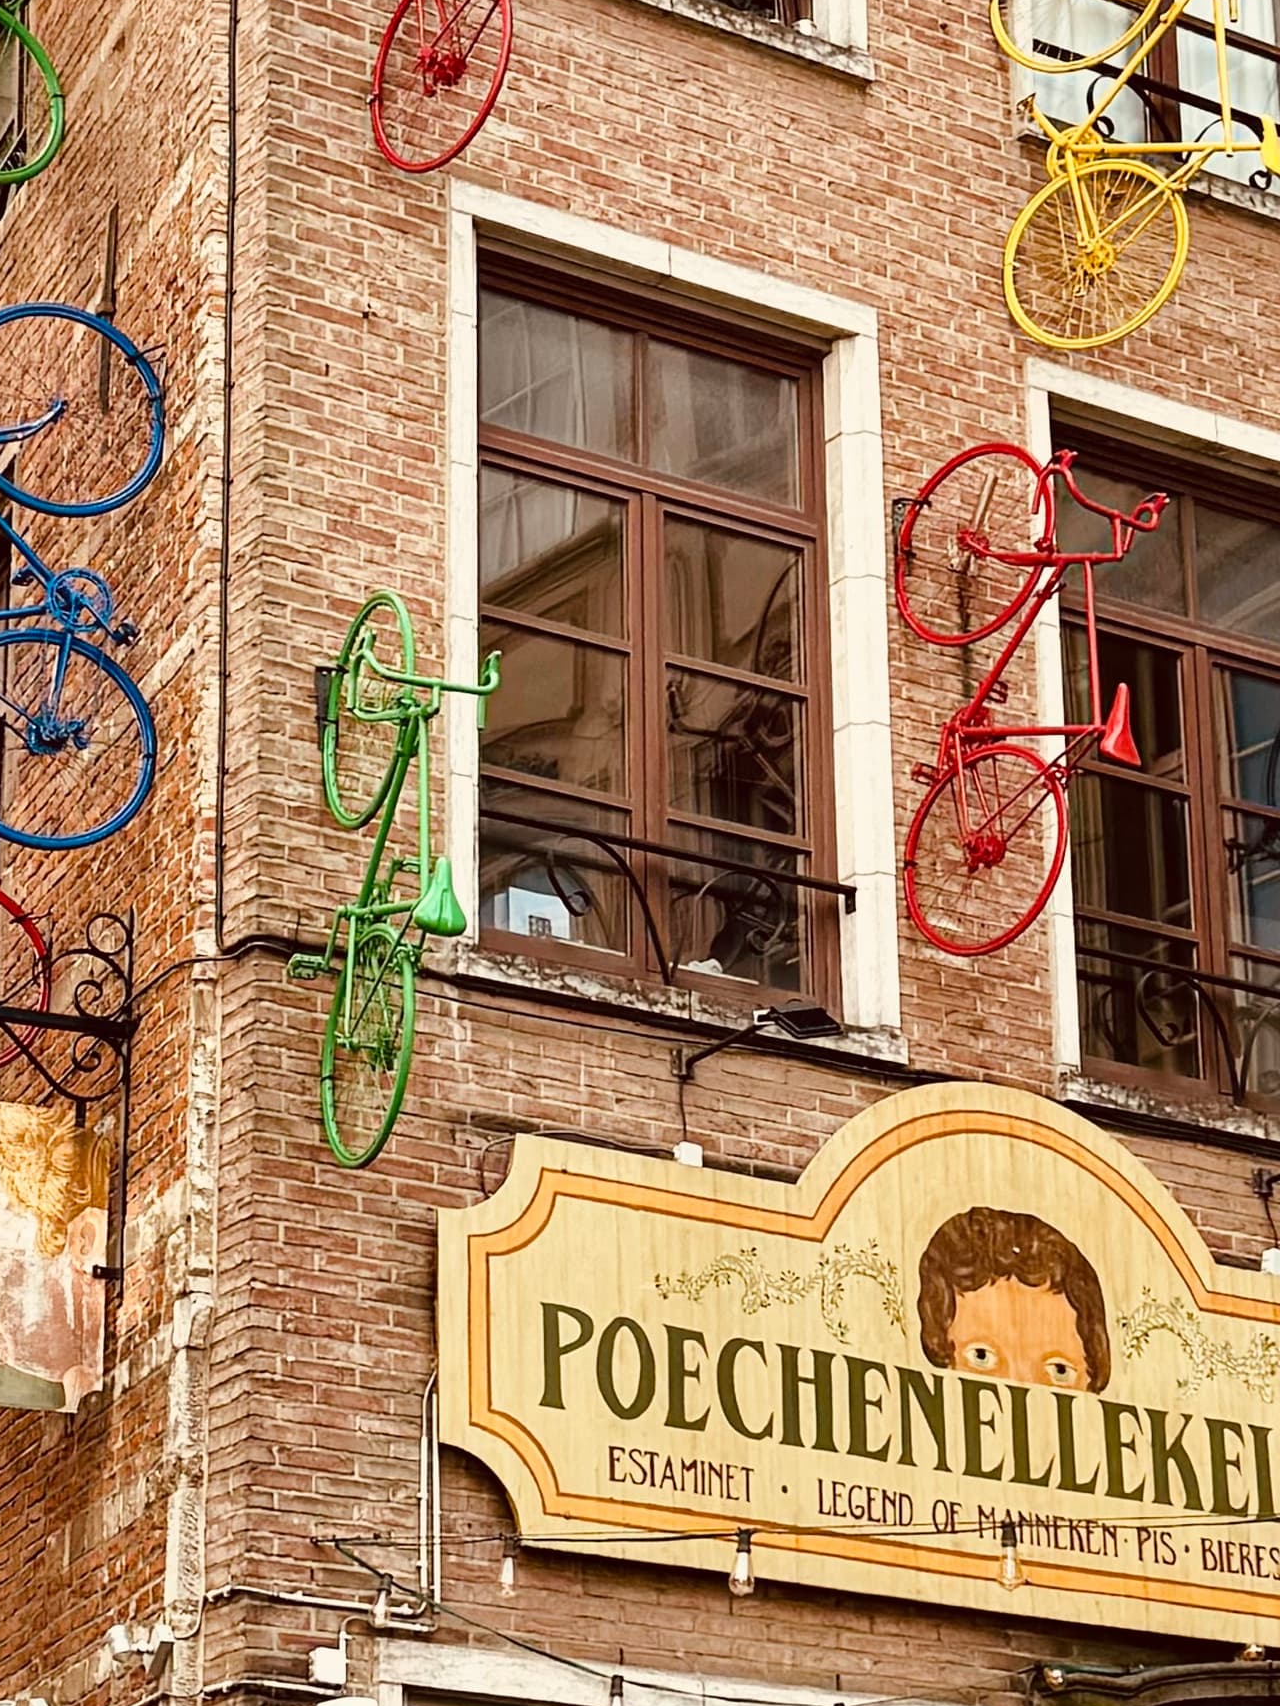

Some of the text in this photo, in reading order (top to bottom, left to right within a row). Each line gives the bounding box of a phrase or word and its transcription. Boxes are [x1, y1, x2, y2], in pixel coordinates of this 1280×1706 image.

[608, 1445, 754, 1503] ESTAMINET
[817, 1479, 913, 1528] LEGEND
[932, 1499, 963, 1534] OF
[1136, 1527, 1177, 1566] PIS
